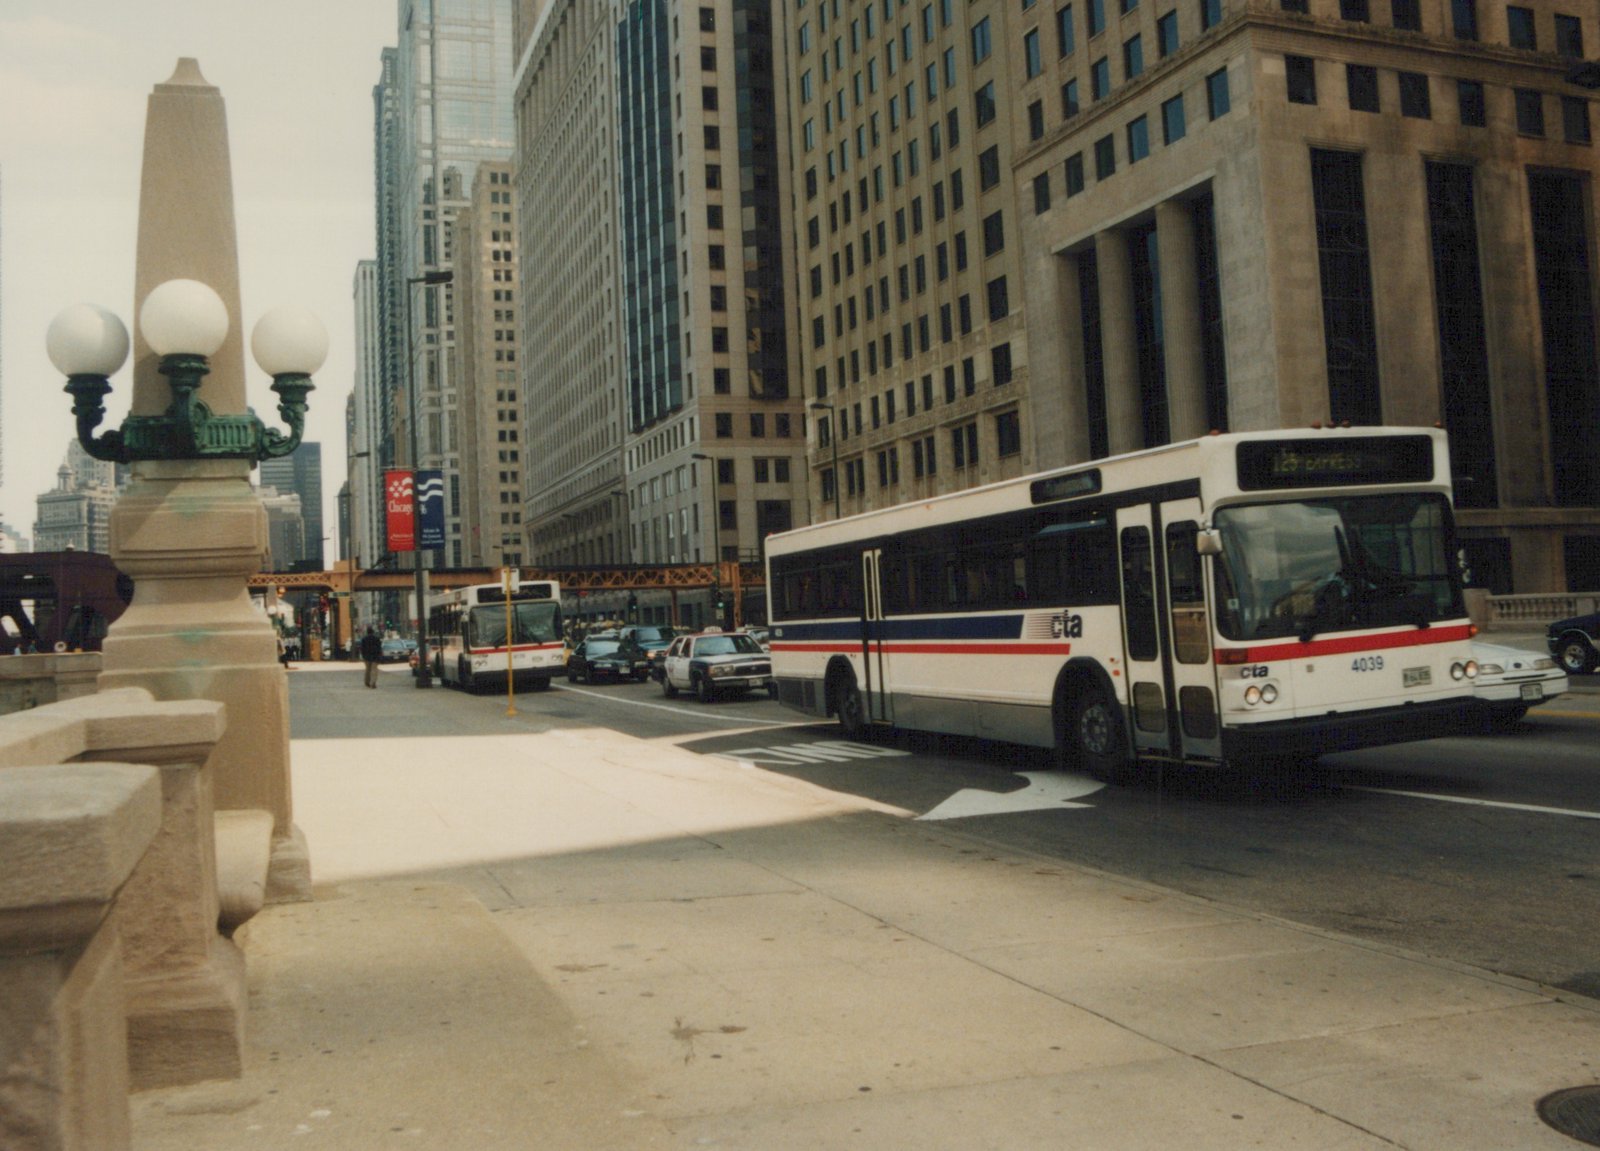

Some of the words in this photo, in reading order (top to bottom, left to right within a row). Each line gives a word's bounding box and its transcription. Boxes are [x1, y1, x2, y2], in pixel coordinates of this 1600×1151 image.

[1050, 609, 1082, 639] cta
[1240, 664, 1269, 680] cta
[1351, 655, 1384, 673] 4039
